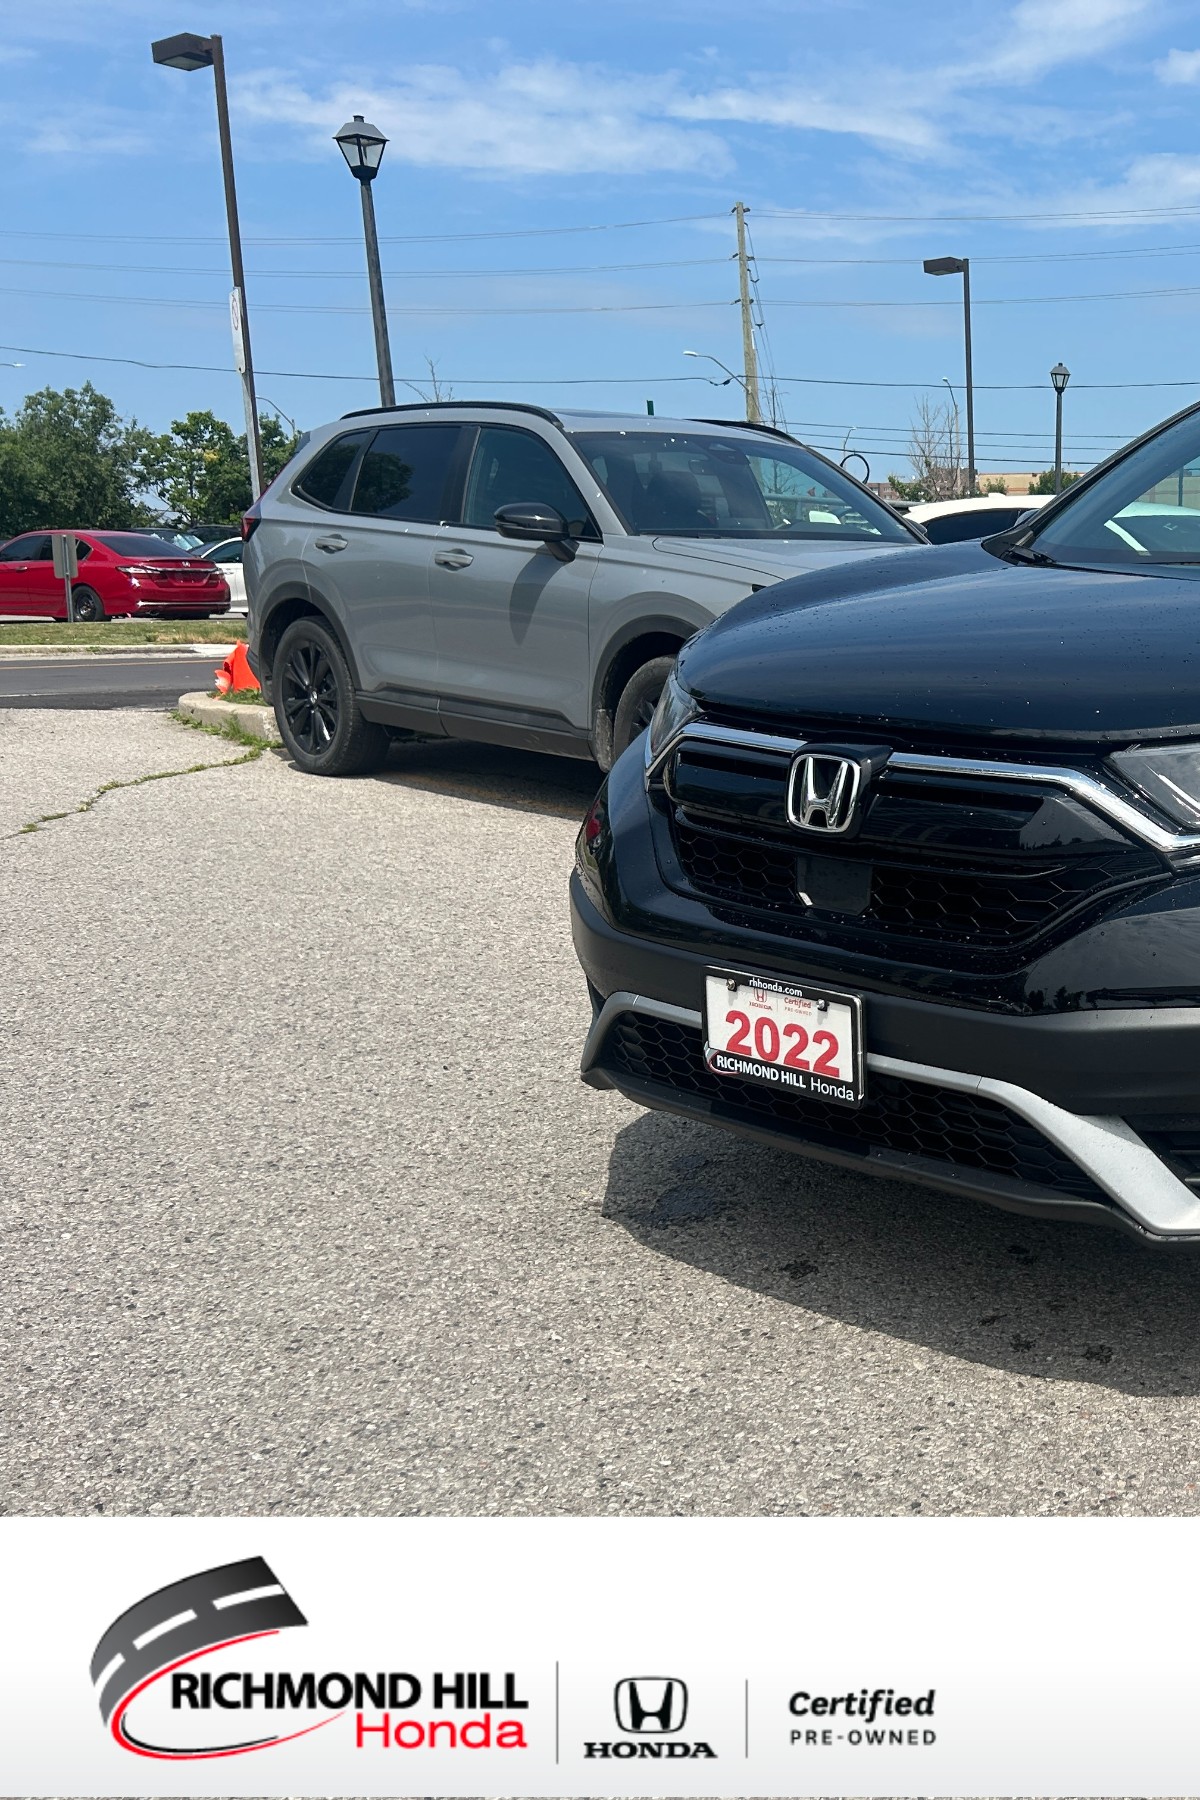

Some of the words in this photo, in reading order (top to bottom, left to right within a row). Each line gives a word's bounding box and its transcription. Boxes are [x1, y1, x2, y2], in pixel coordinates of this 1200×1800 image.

[749, 977, 803, 997] rhhonda.com
[784, 997, 812, 1008] Certified
[725, 1010, 840, 1078] 2022
[716, 1055, 779, 1081] RICHMOND
[780, 1070, 807, 1088] HILL
[810, 1077, 855, 1101] Honda
